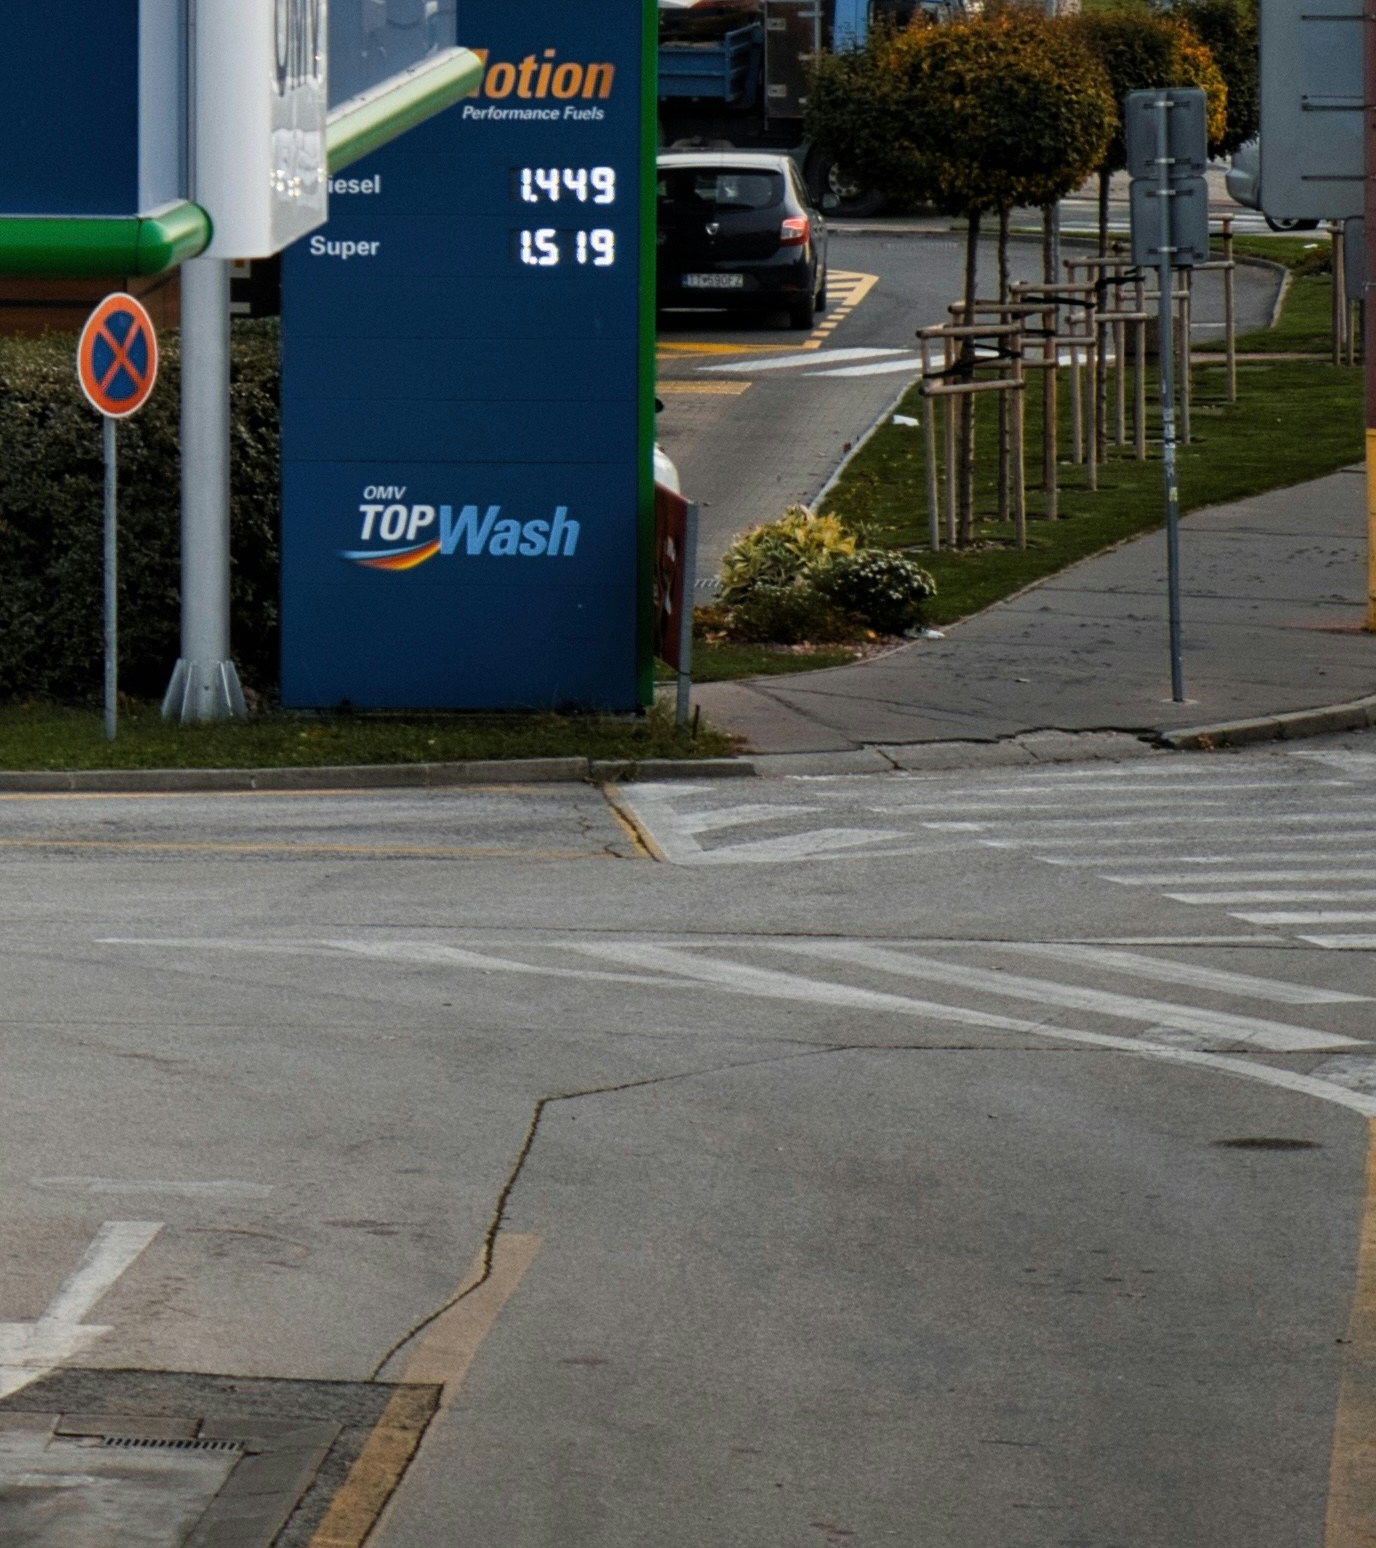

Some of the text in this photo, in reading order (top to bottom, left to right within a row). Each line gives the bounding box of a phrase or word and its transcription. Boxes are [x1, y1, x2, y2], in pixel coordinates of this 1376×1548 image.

[462, 105, 605, 120] Performance Fuels
[328, 166, 616, 204] iesel 1.449
[309, 228, 616, 266] Super 1.519
[363, 486, 406, 500] OMV
